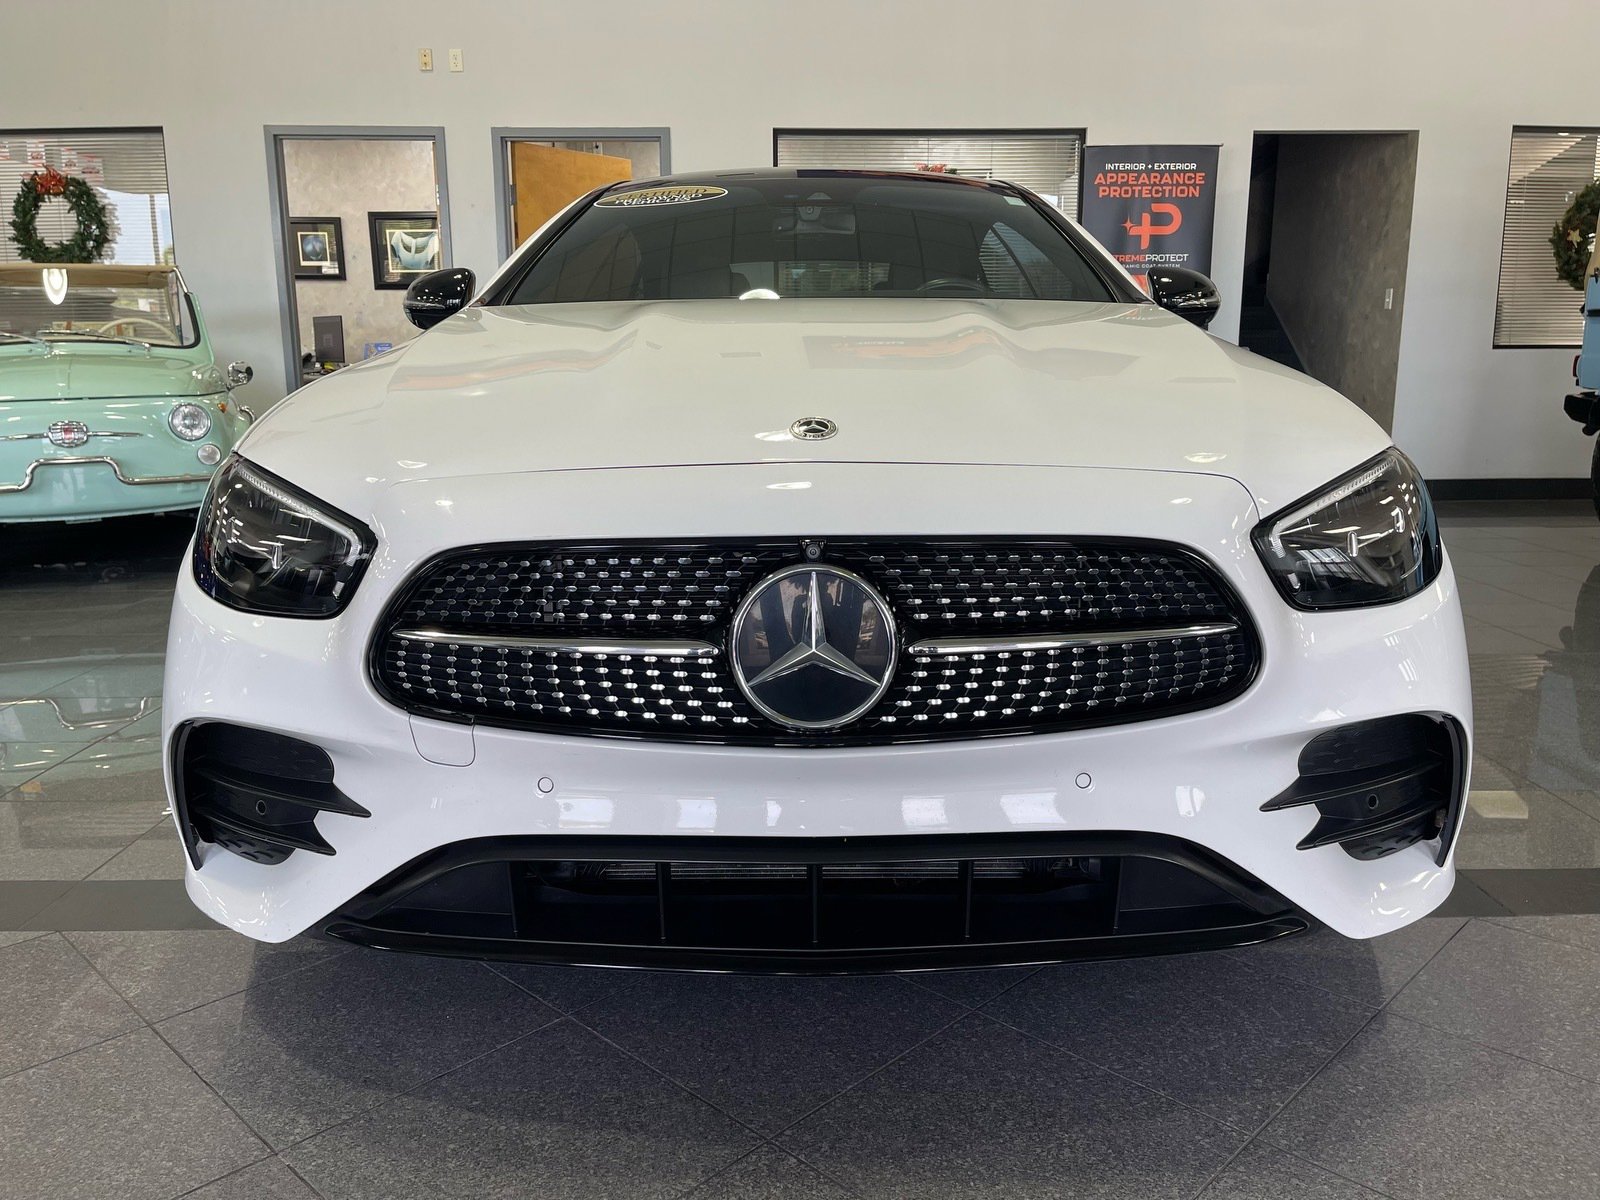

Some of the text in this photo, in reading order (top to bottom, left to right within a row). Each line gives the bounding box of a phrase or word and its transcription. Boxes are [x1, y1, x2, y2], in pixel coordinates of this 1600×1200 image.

[1105, 163, 1146, 171] INTERIOR
[1154, 163, 1198, 171] EXTERIOR
[1094, 172, 1206, 185] APPEARANCE
[1098, 186, 1201, 198] PROTECTION
[1112, 254, 1189, 262] TREMEPROTECT
